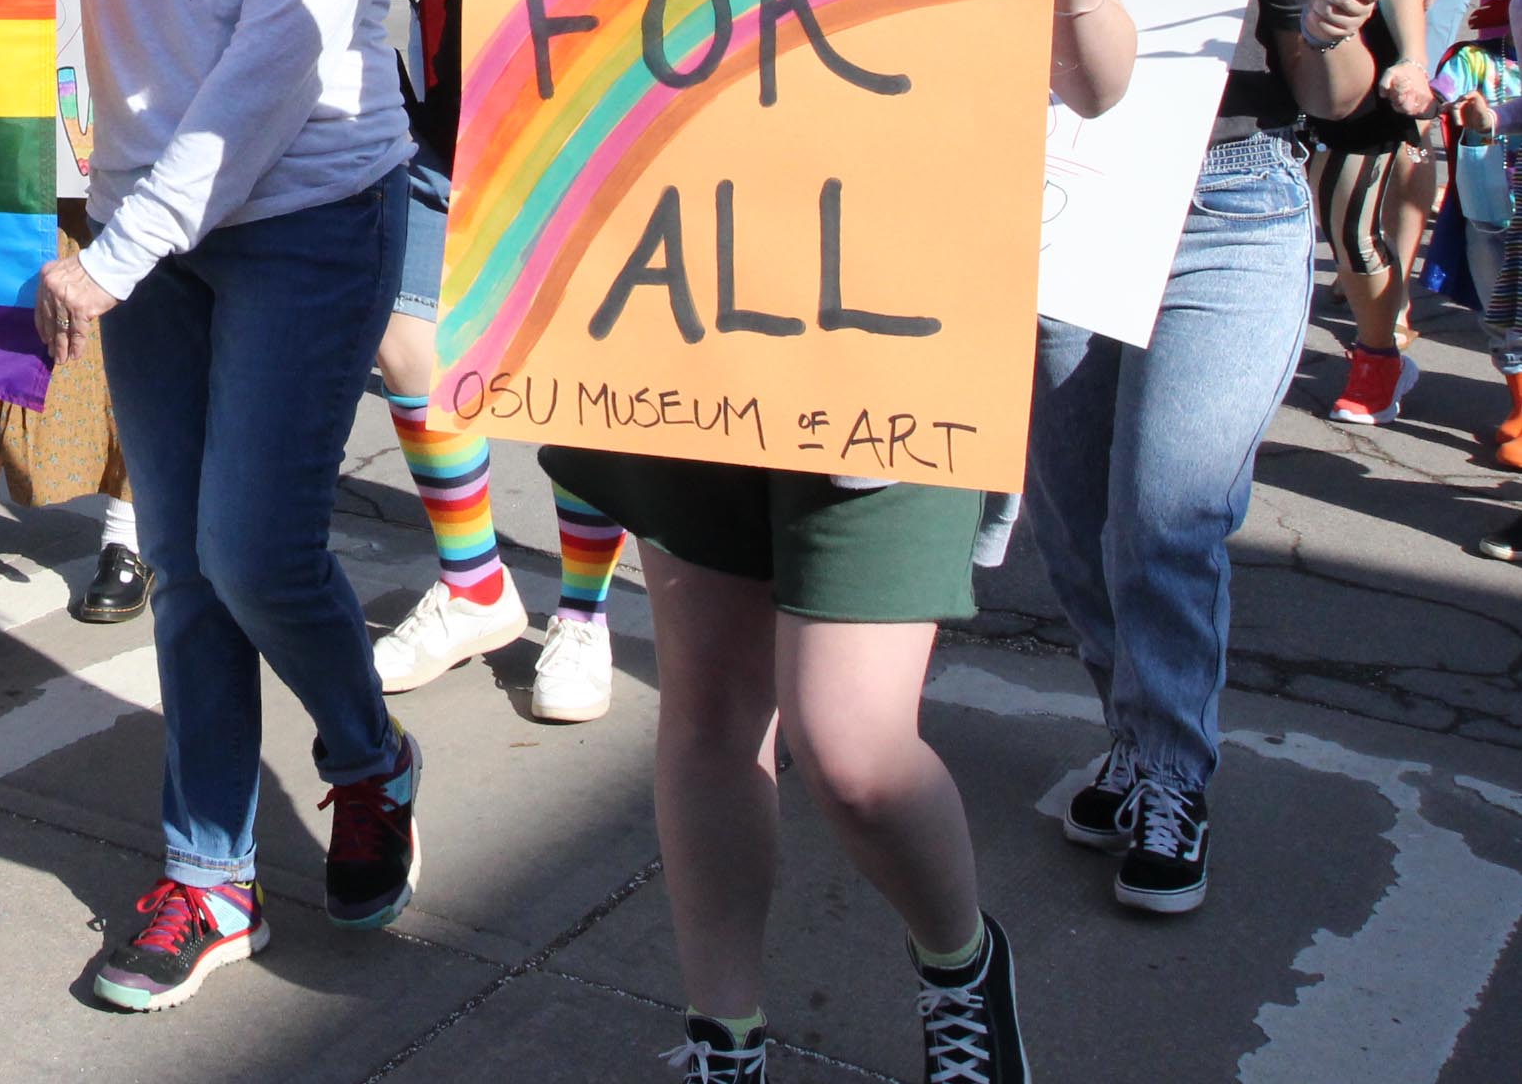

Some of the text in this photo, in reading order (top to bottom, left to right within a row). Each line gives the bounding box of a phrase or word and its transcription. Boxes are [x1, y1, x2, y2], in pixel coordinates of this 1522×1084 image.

[588, 177, 942, 344] ALL
[453, 371, 977, 473] OSU MUSEUM OF ART
